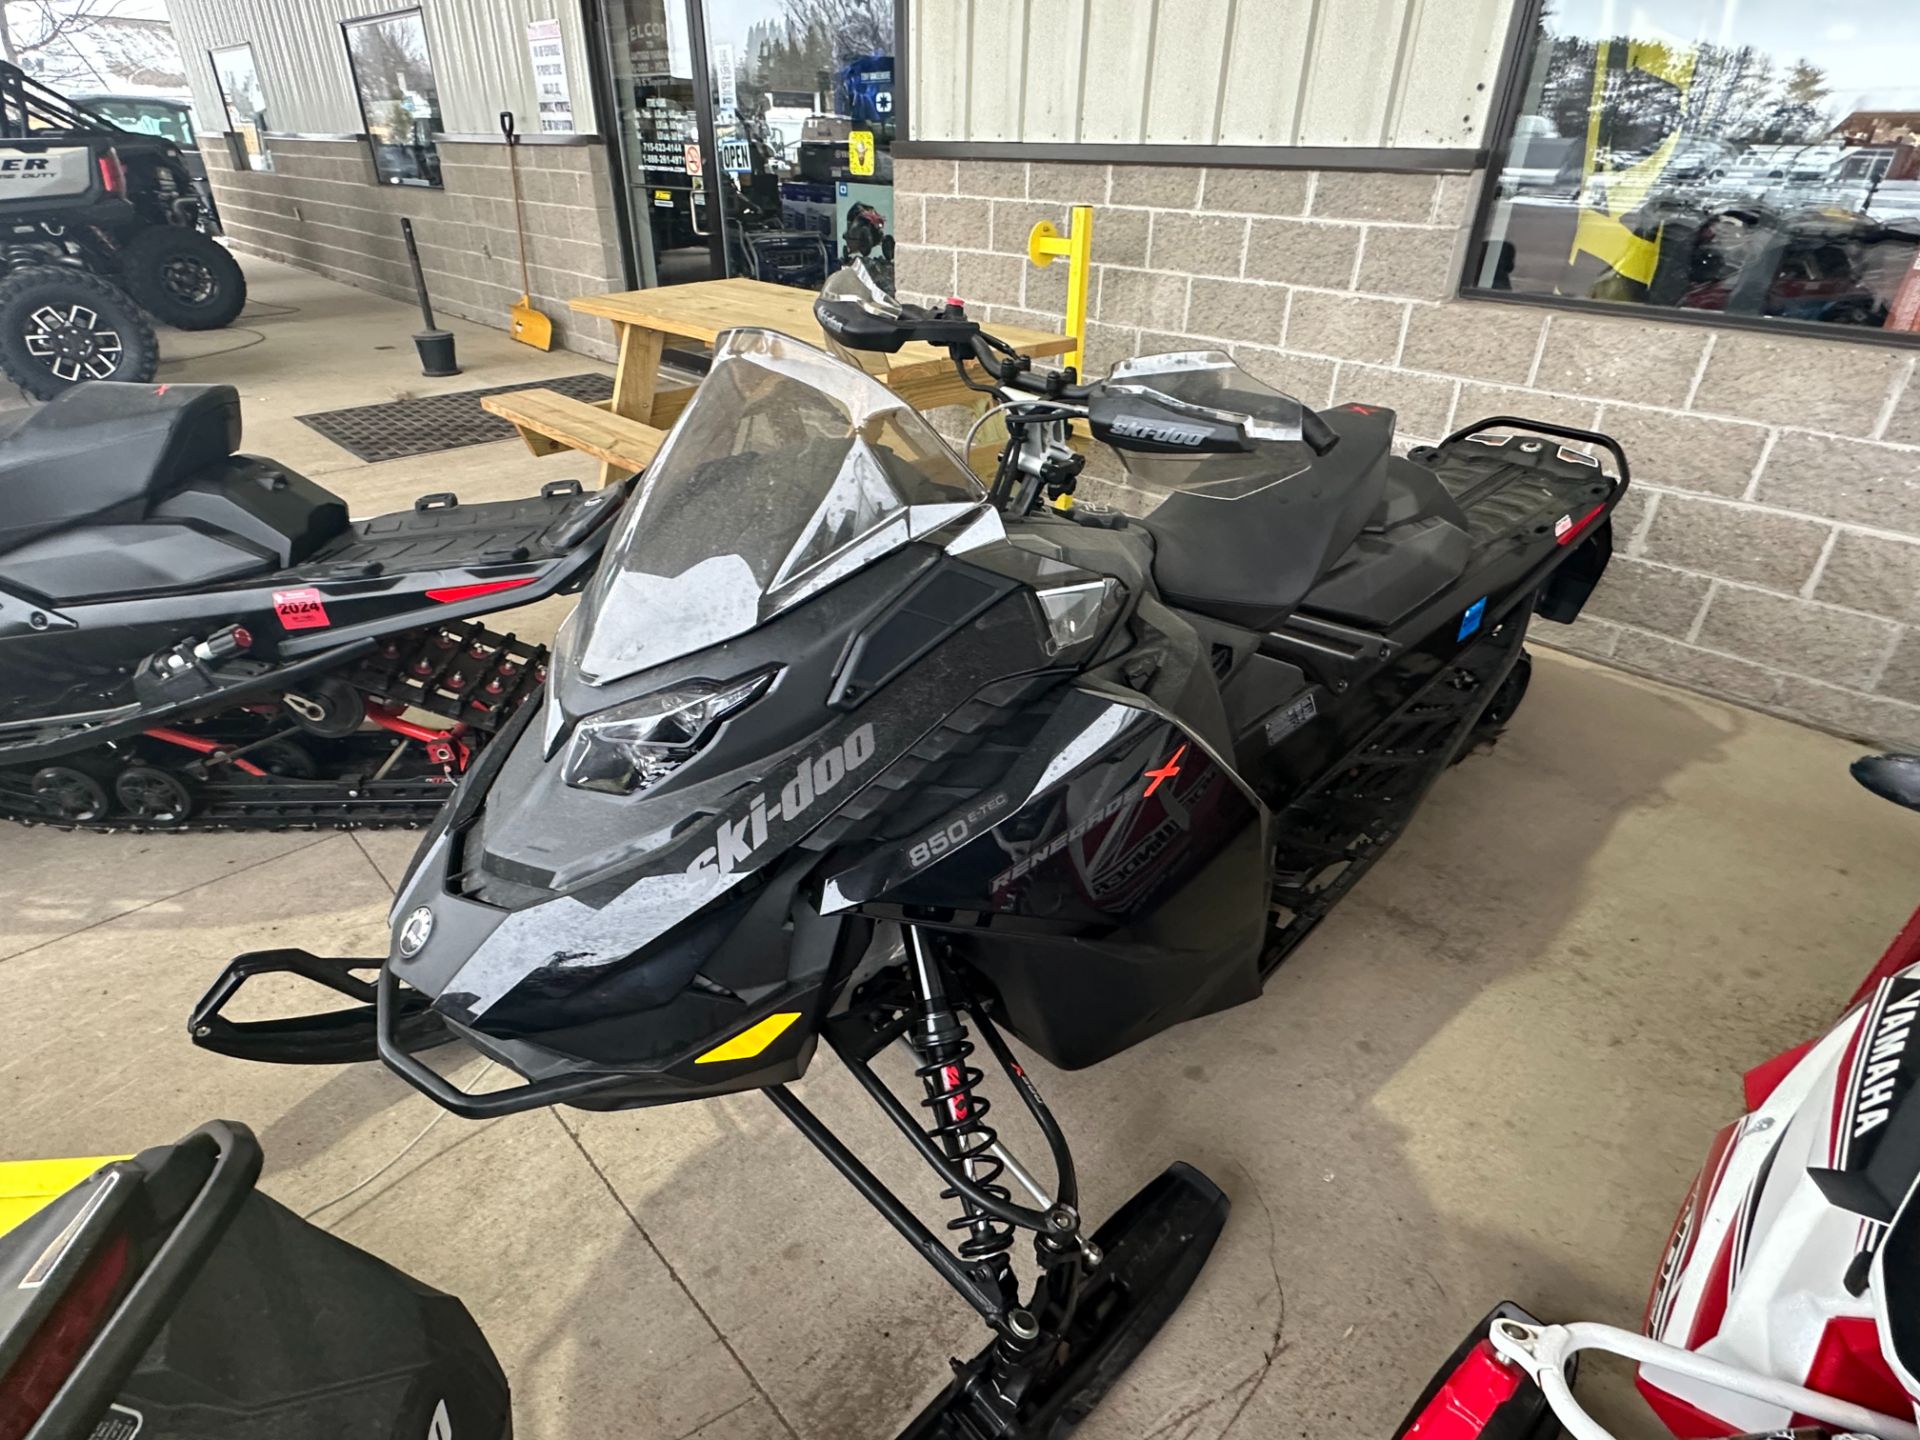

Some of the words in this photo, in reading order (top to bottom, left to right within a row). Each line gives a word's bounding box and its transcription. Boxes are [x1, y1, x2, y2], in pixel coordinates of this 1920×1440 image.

[723, 145, 749, 168] OPEN
[279, 601, 319, 615] 2024
[909, 820, 968, 867] 850
[967, 794, 1007, 823] E-TEC
[991, 786, 1144, 895] RENEGADE
[1853, 988, 1920, 1139] YAMAHA
